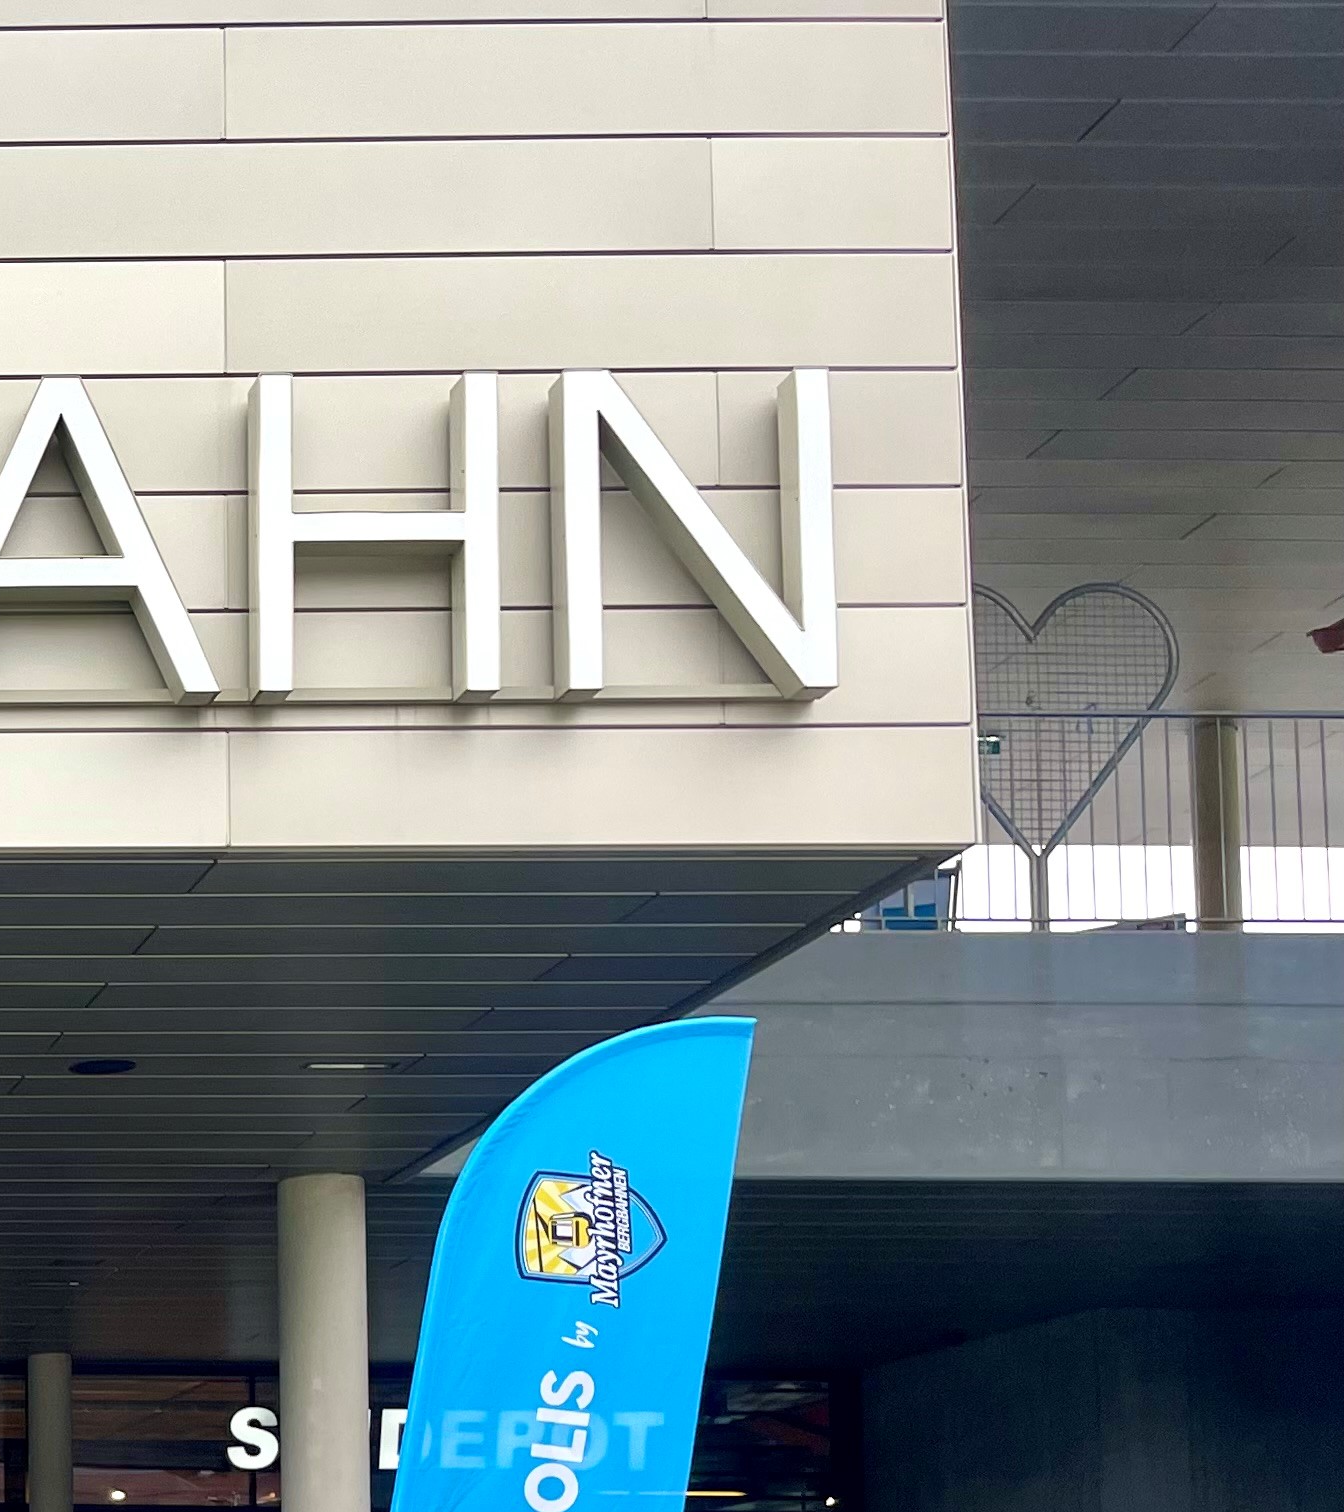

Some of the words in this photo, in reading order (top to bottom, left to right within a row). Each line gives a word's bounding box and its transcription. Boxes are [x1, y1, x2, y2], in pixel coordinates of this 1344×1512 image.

[584, 1150, 622, 1309] Mayrhofner
[612, 1166, 632, 1254] BERGBAHNEN
[561, 1320, 599, 1349] by
